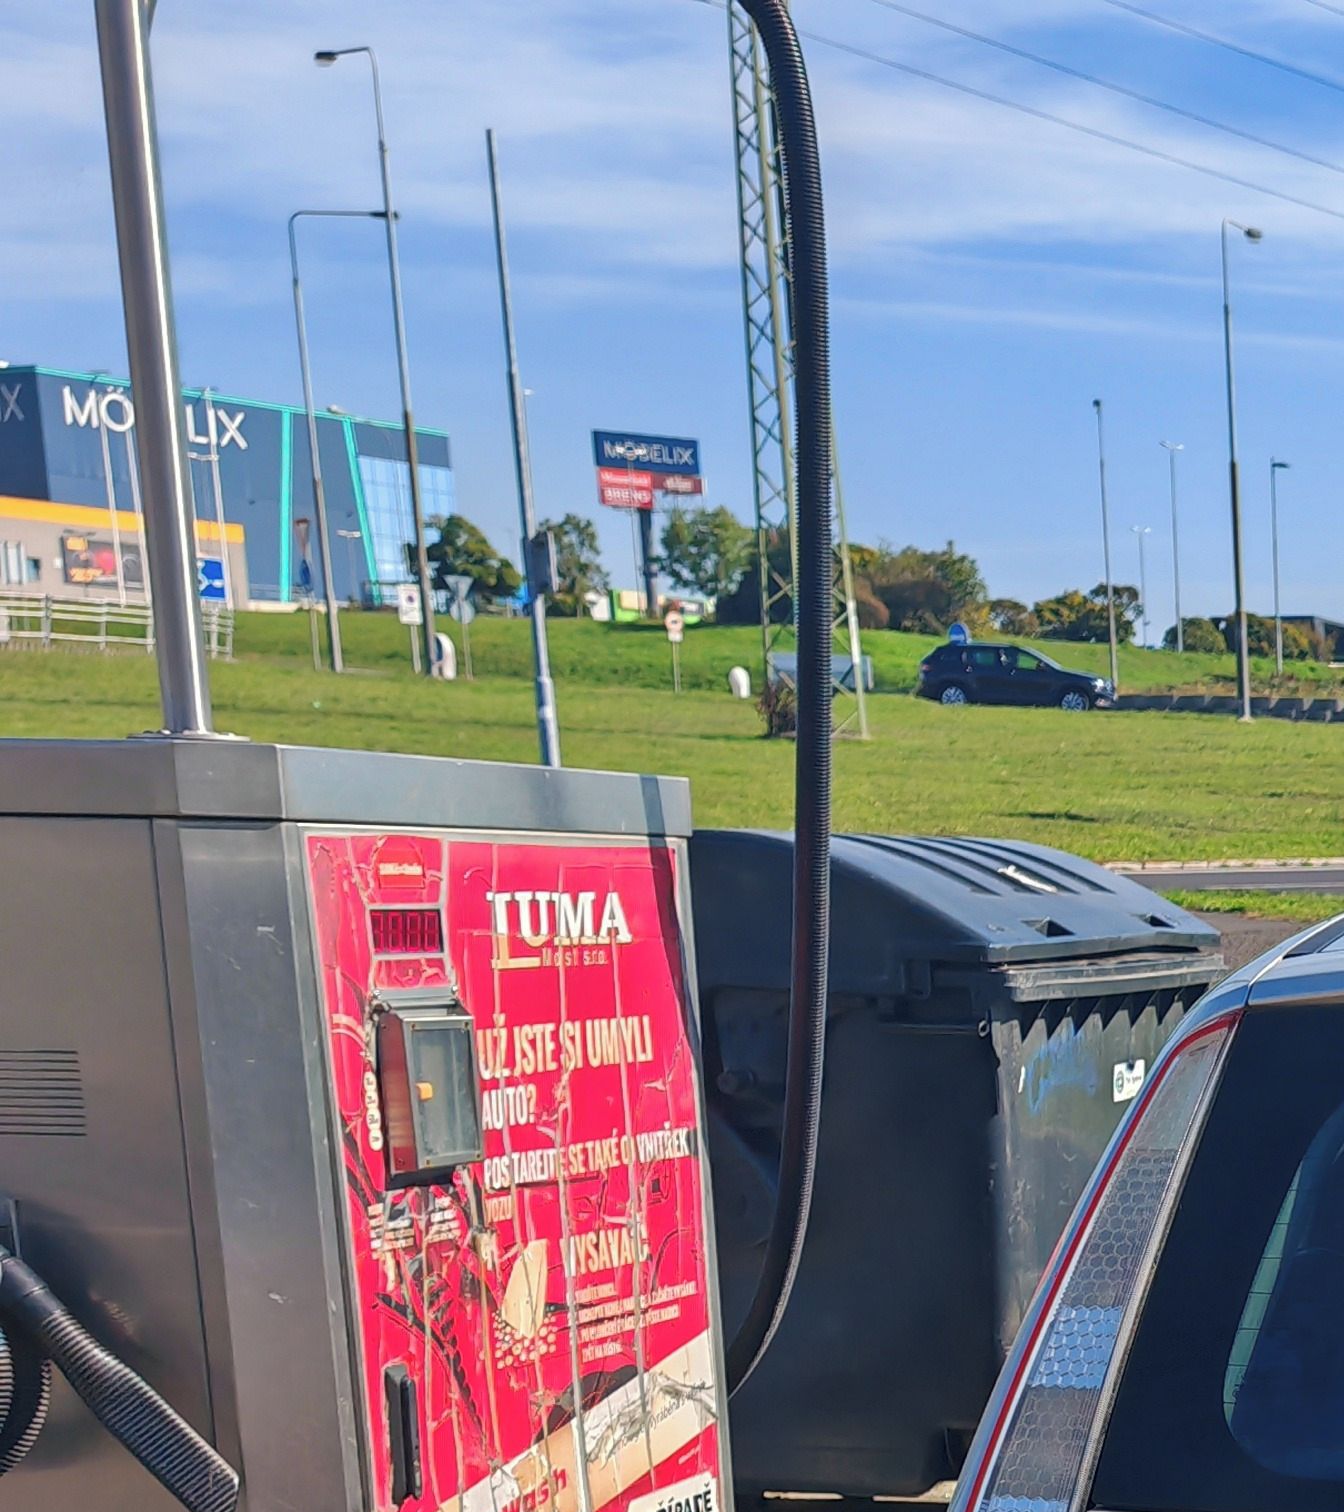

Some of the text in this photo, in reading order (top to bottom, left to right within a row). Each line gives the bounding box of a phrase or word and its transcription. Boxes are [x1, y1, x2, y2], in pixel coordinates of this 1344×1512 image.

[62, 385, 248, 450] MÖLIX
[476, 1013, 654, 1080] UŽ JSTE SI UMYLI
[482, 1084, 537, 1130] AUTO?
[567, 1142, 585, 1176] SE
[585, 1128, 619, 1170] TAKÉ
